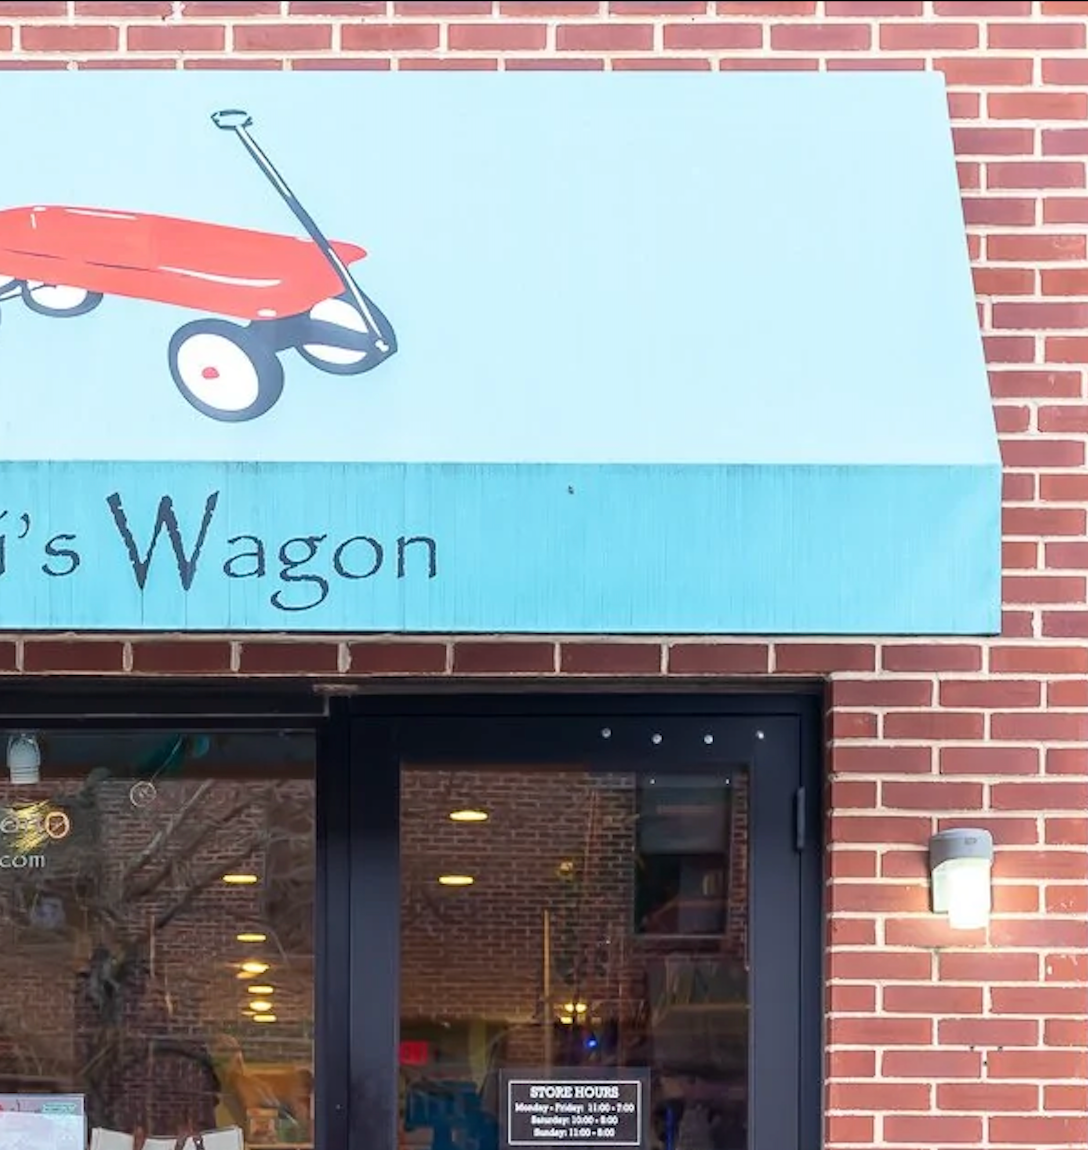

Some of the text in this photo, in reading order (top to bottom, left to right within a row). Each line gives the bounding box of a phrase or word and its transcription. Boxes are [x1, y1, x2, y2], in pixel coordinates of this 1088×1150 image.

[106, 490, 437, 611] Wagon
[530, 1085, 619, 1099] STORE HOURS
[515, 1102, 549, 1113] Monday
